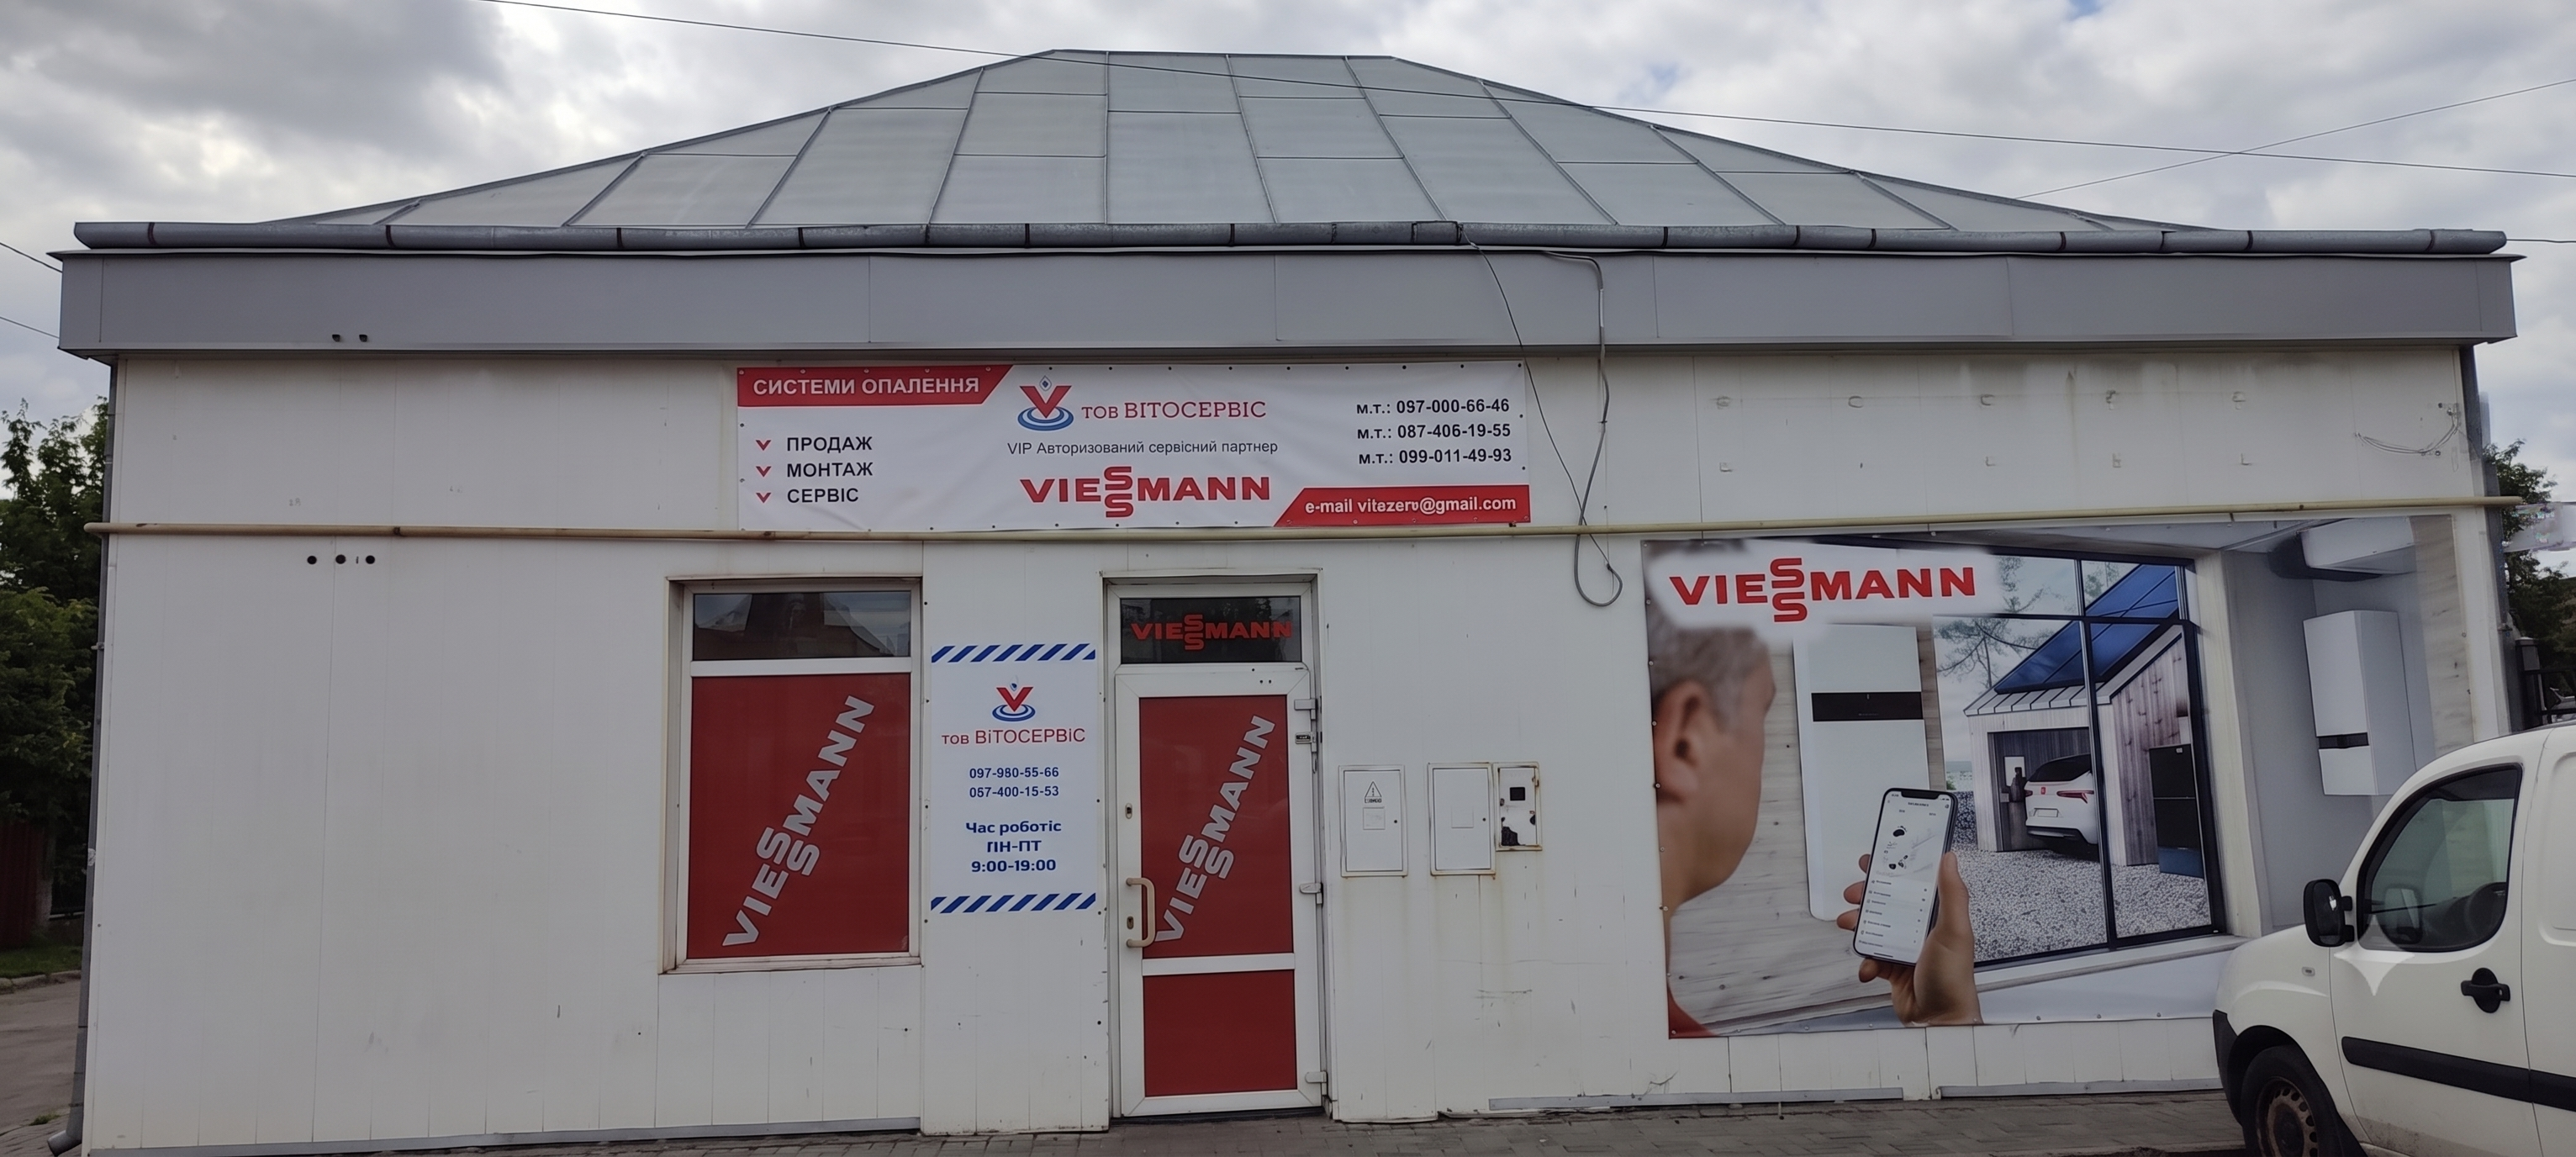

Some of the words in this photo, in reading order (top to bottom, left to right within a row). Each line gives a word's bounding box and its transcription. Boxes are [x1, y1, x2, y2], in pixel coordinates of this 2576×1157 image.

[753, 378, 855, 395] СИСТЕМИ
[862, 377, 979, 394] ОПАЛЕННЯ
[1124, 401, 1266, 419] ВІТОСЕРВІС
[1396, 399, 1510, 414] 097-000-66-46
[1397, 423, 1511, 438] 087-406-19-55
[786, 436, 874, 454] ПРОДАЖ
[1007, 442, 1032, 455] VIP
[1037, 441, 1144, 457] Авторизований
[1148, 441, 1217, 456] сервісний
[1222, 442, 1278, 455] партнер
[1399, 448, 1512, 463] 099-011-49-93
[786, 462, 874, 478] МОНТАЖ
[786, 488, 858, 504] СЕРВІС
[1020, 466, 1270, 518] VIESSMANN
[1305, 499, 1353, 514] e-mail
[1669, 557, 1976, 623] VIESSMANN
[1130, 614, 1292, 650] VIESSMANN
[969, 767, 1059, 779] 097-980-55-66
[721, 695, 875, 947] VIESSMANN
[965, 822, 995, 833] Час
[1154, 715, 1276, 942] VIESSMANN
[971, 859, 1056, 872] 9:00-19:00
